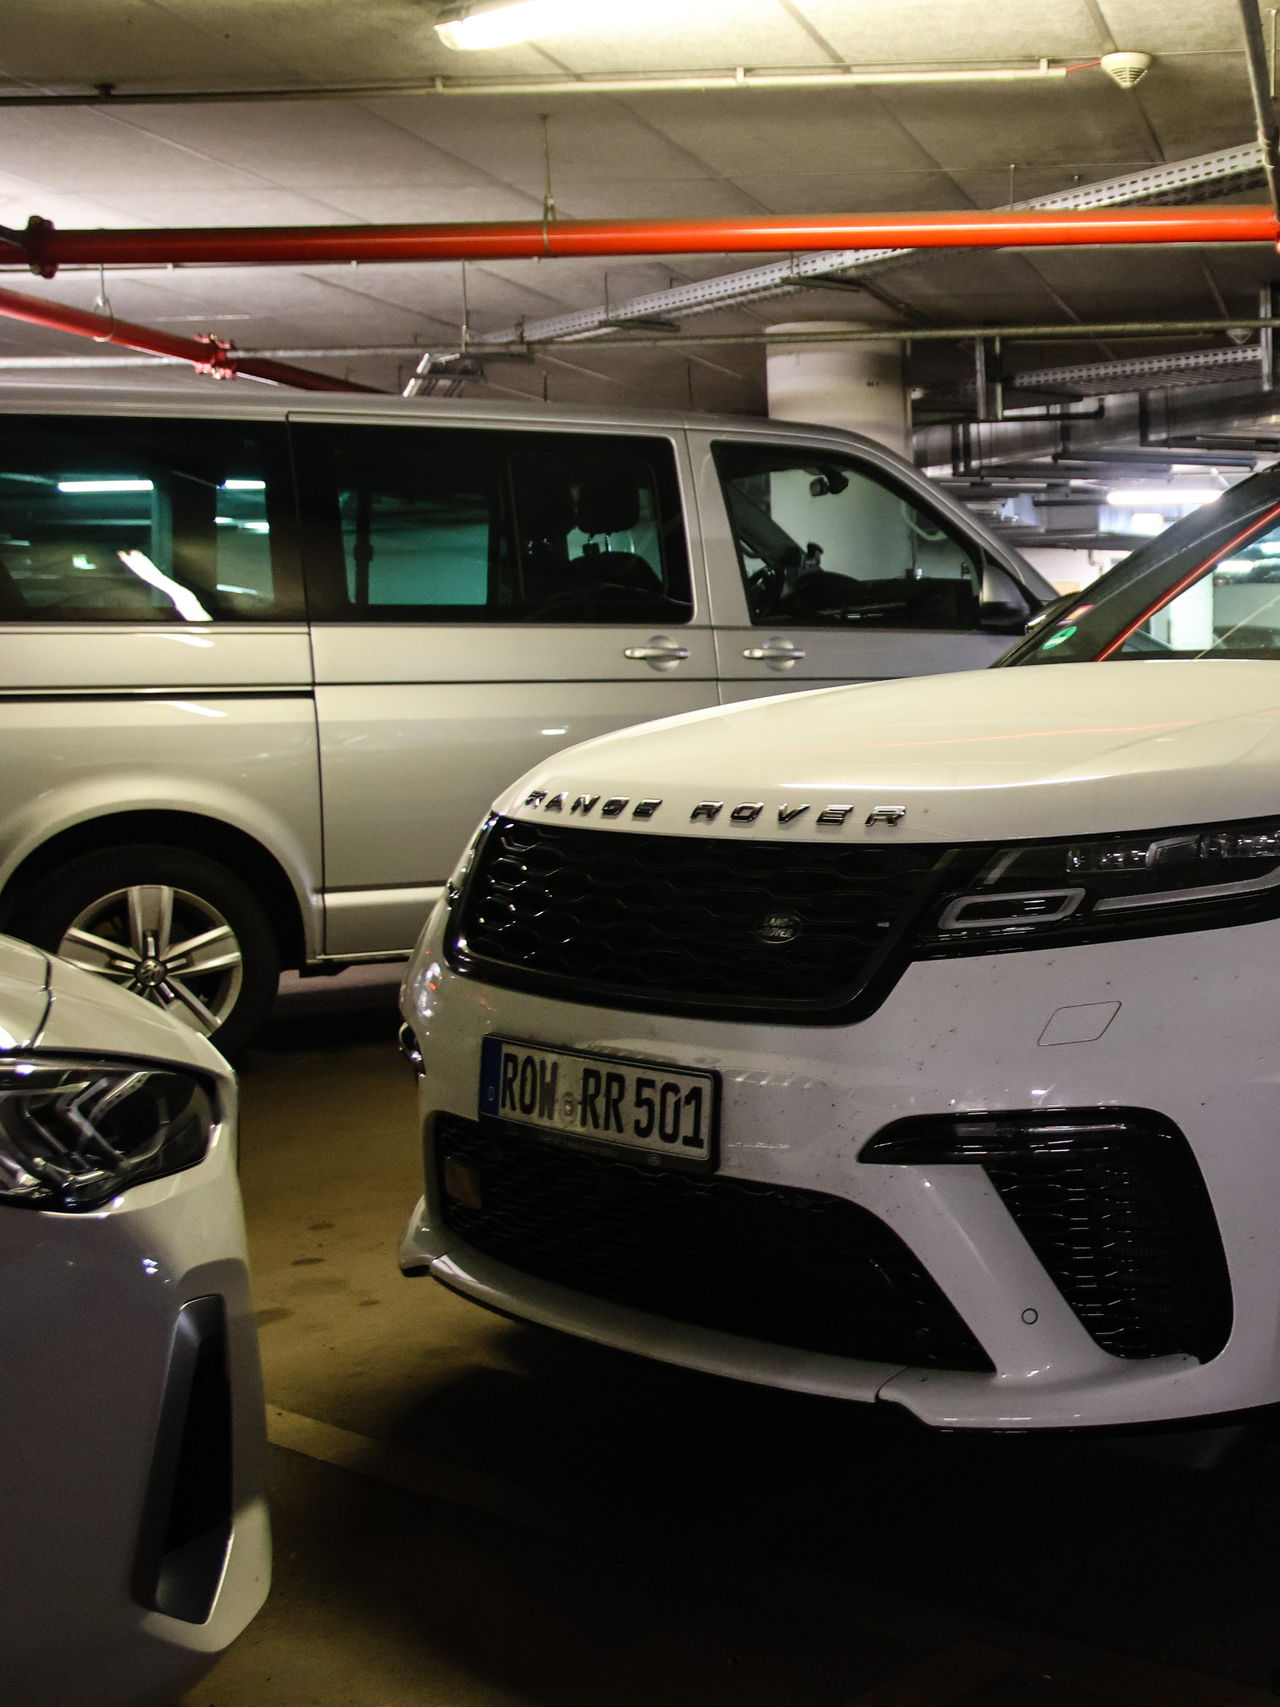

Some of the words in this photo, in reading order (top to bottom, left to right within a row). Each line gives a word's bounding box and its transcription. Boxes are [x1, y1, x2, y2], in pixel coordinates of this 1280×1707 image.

[525, 789, 662, 817] RANGE
[690, 801, 906, 826] ROVER
[501, 1053, 558, 1120] ROW
[580, 1068, 626, 1134] RR
[633, 1076, 705, 1149] 501
